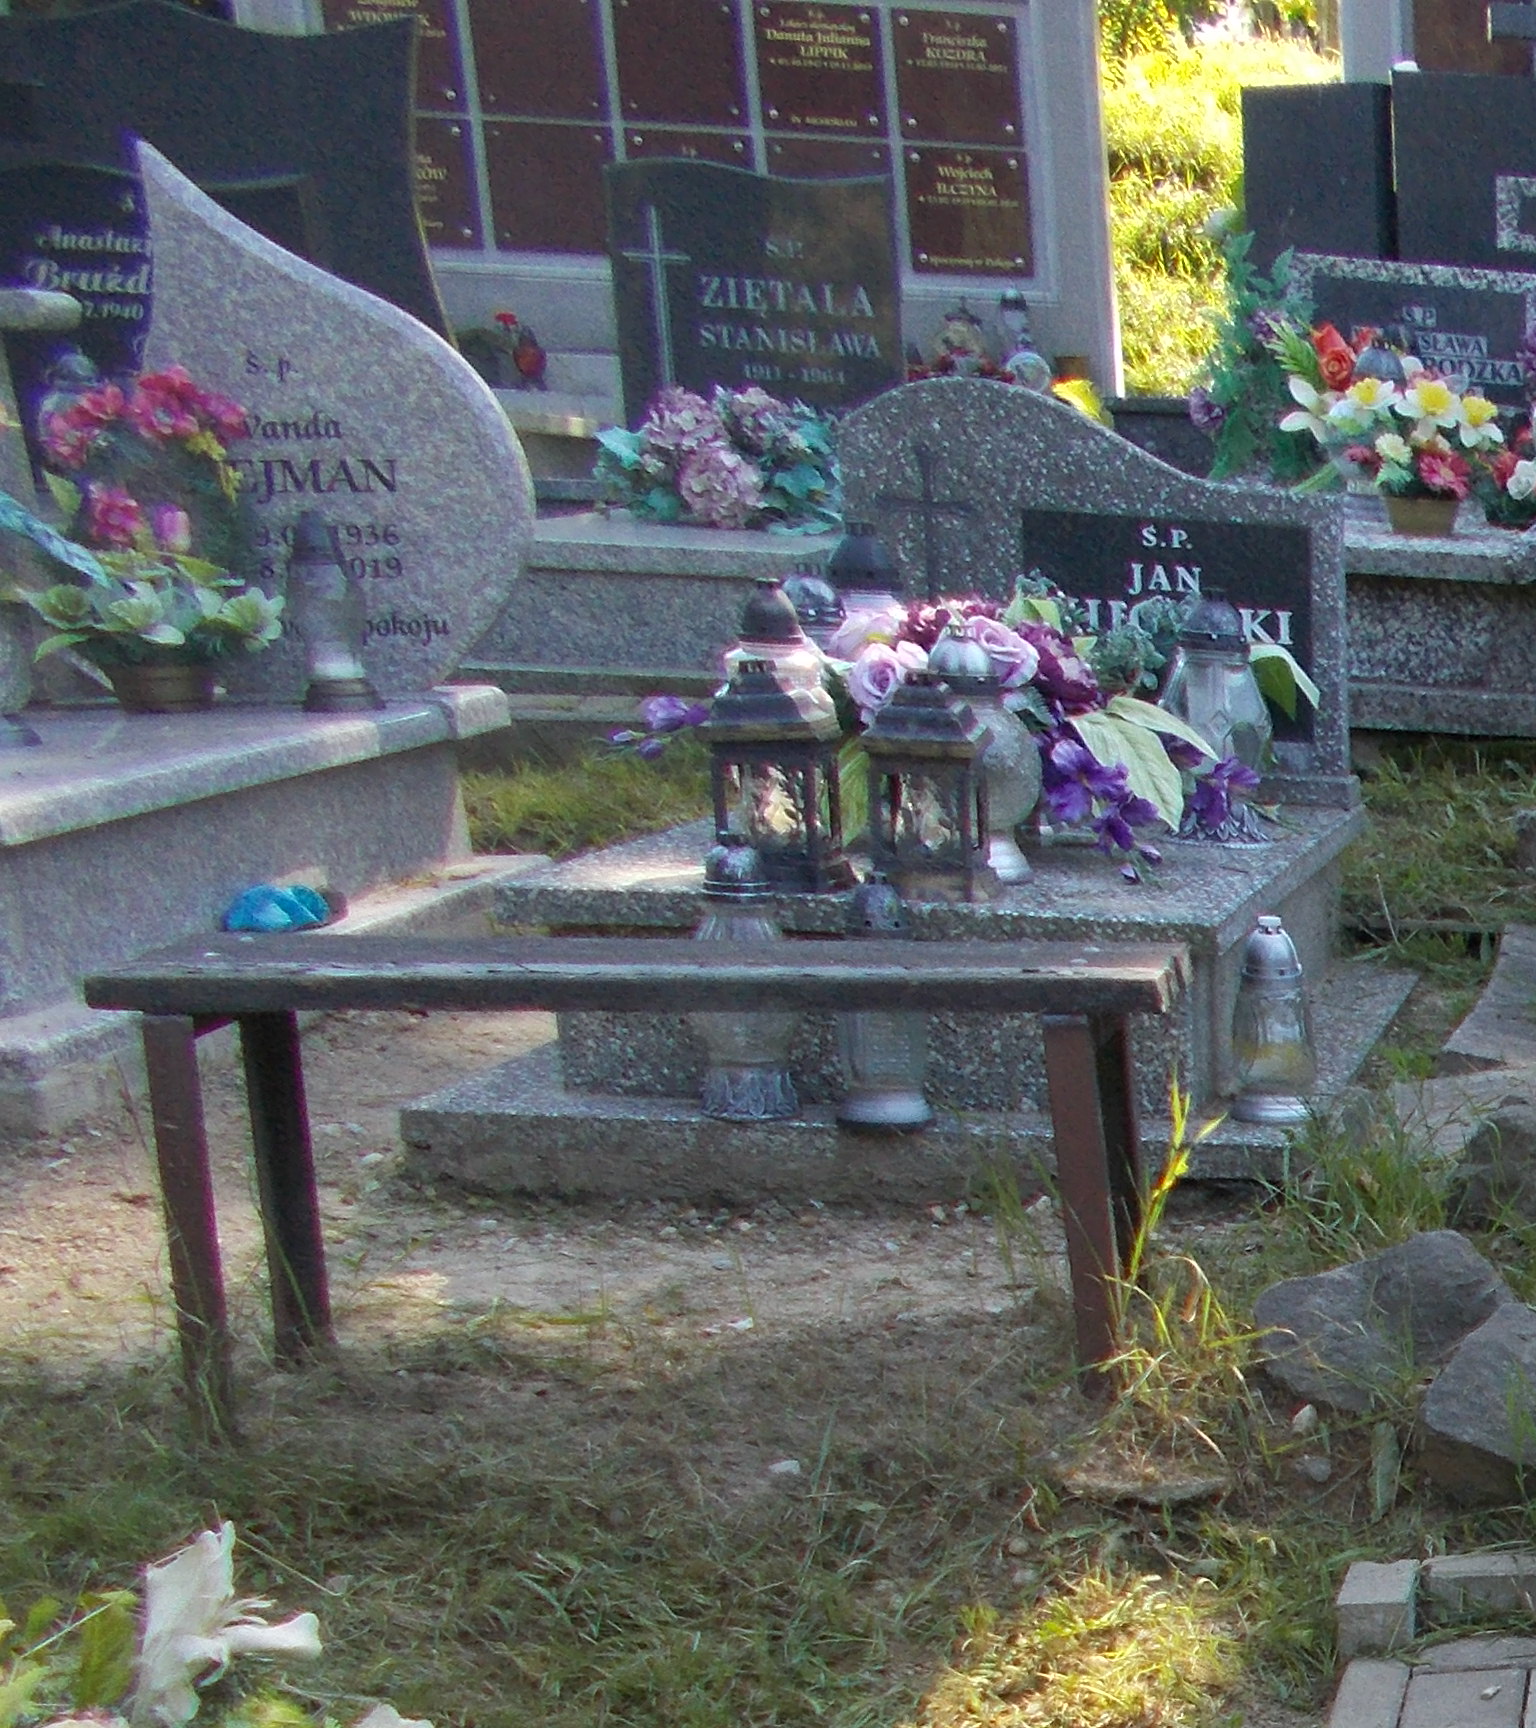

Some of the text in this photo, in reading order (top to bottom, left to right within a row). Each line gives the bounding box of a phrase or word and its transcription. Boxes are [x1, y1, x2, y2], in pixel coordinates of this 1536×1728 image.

[82, 300, 144, 320] 7.1940
[228, 458, 399, 504] EJMAN
[1127, 563, 1200, 595] JAN
